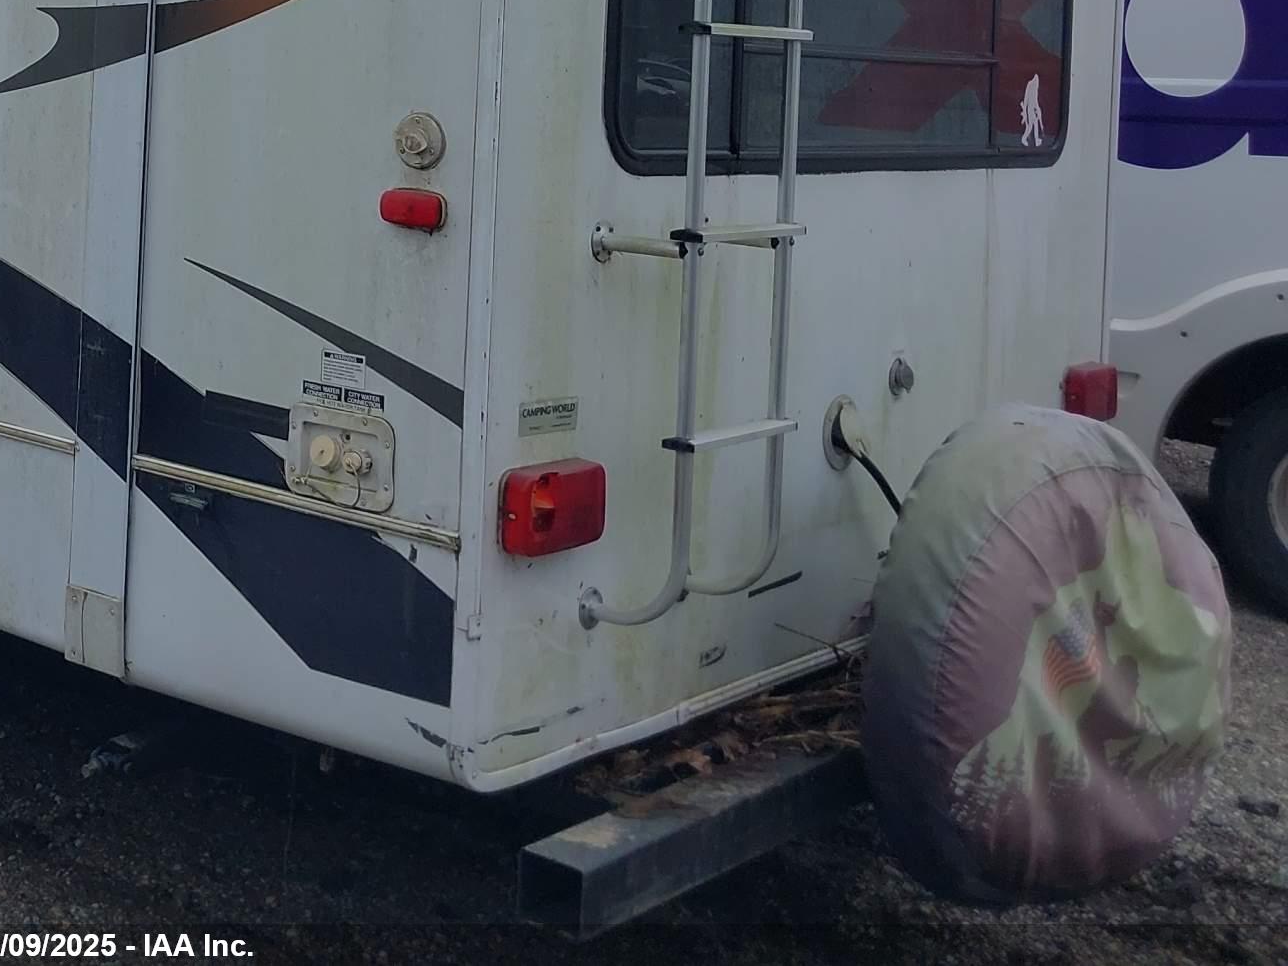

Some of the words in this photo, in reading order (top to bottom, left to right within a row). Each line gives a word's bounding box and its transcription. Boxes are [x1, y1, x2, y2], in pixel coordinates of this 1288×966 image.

[305, 389, 338, 400] CONNECTION
[323, 386, 340, 394] WATER
[348, 391, 360, 399] CITY
[361, 393, 380, 402] WATER
[347, 398, 381, 409] CONNECTION
[522, 406, 551, 418] CAMPING
[552, 403, 576, 413] WORLD
